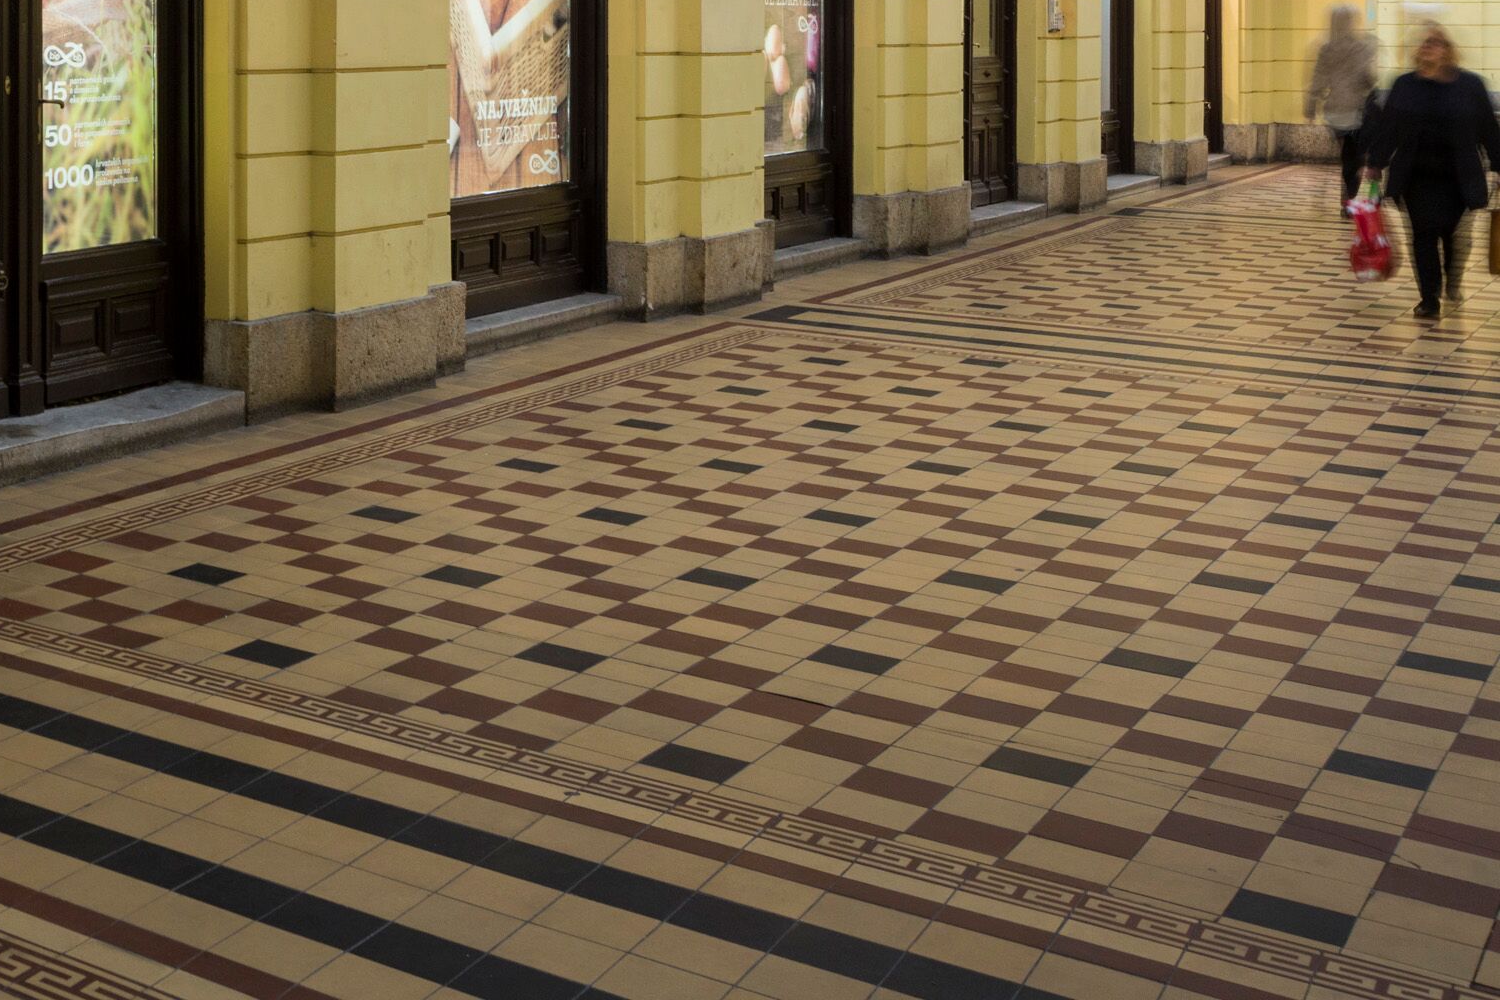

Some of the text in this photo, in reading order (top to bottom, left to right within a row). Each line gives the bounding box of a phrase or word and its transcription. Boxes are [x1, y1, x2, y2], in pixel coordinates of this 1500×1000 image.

[45, 80, 68, 102] 15
[476, 89, 558, 120] NAJVAŽNIJE
[45, 124, 72, 147] 50
[476, 121, 560, 147] JE ZDRAVLJE.
[45, 163, 94, 190] 1000
